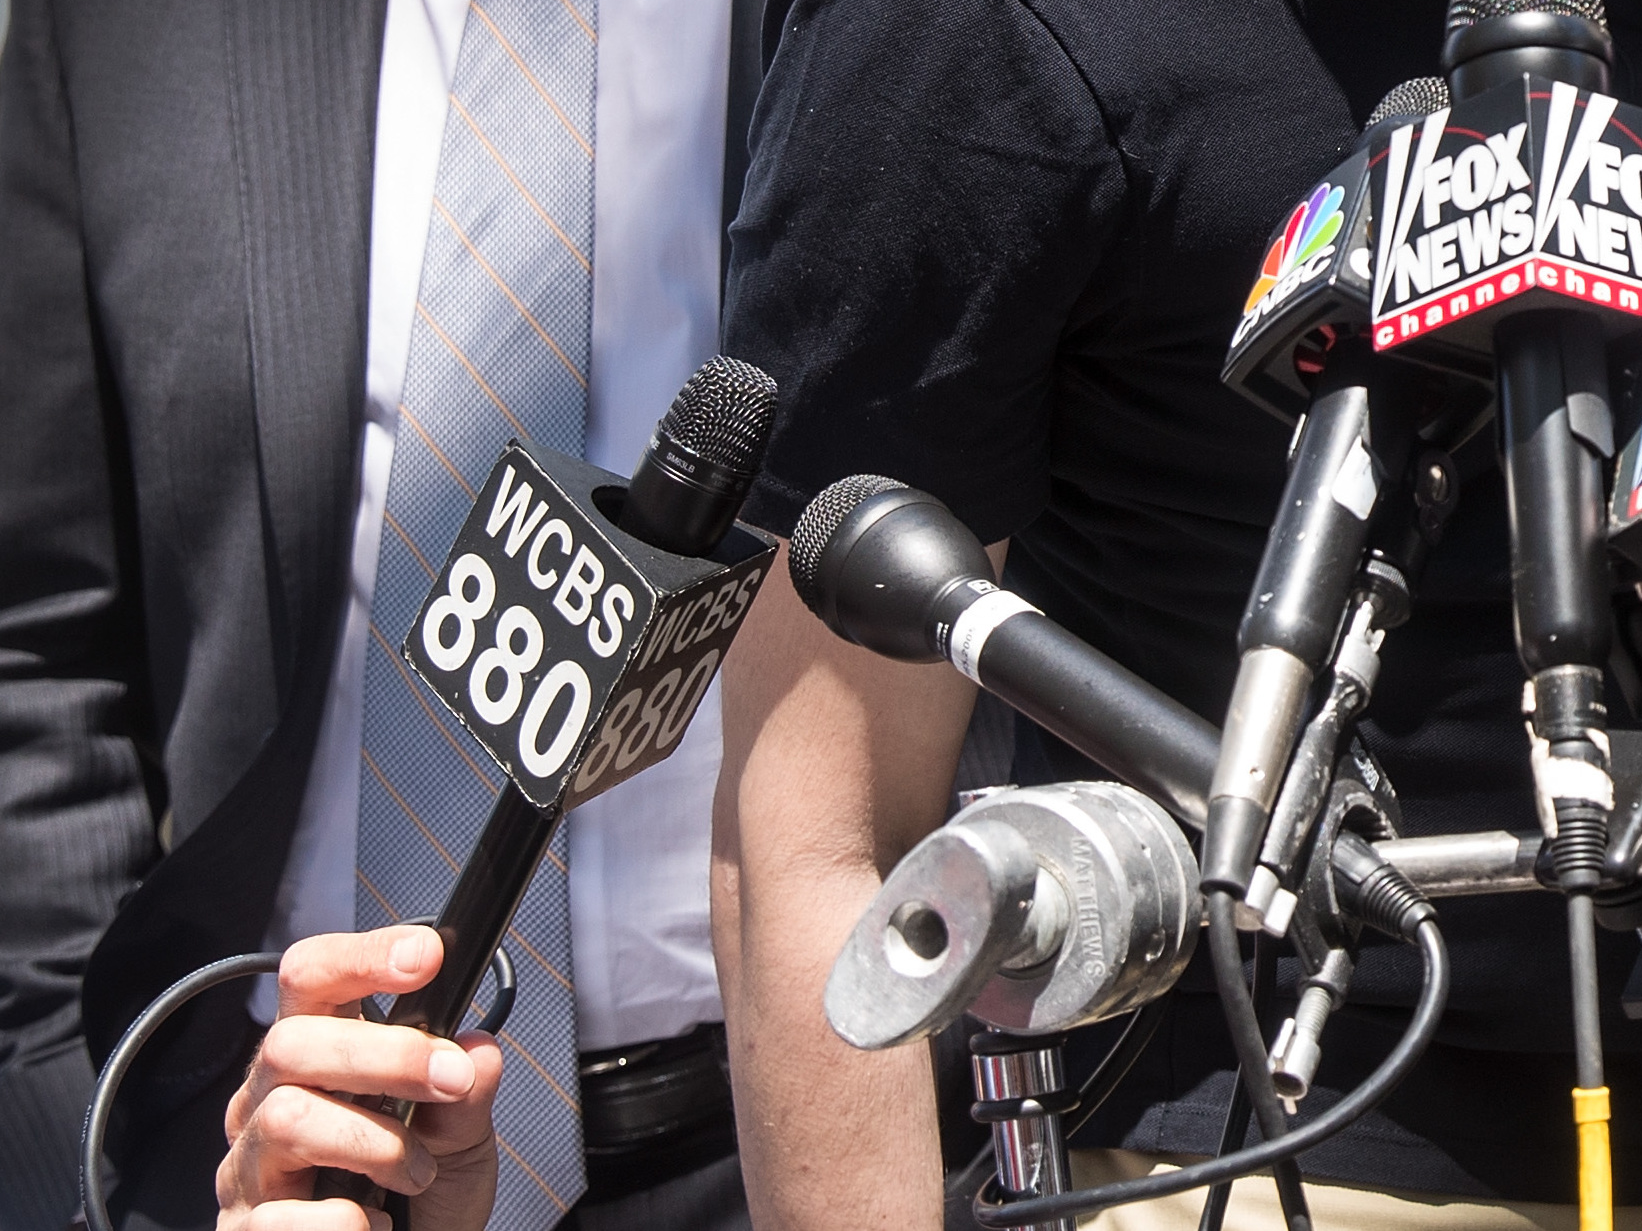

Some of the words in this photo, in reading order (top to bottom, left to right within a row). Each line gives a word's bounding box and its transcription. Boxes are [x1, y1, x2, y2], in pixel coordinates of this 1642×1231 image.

[1423, 122, 1532, 228] FOX
[1231, 245, 1336, 348] CNBC
[1375, 259, 1536, 347] channel
[1395, 193, 1534, 303] NEWS
[485, 464, 635, 659] WCBS
[422, 552, 592, 779] 880
[637, 567, 762, 672] WCBS
[573, 648, 720, 794] 880
[1071, 836, 1107, 979] MATTHEWS
